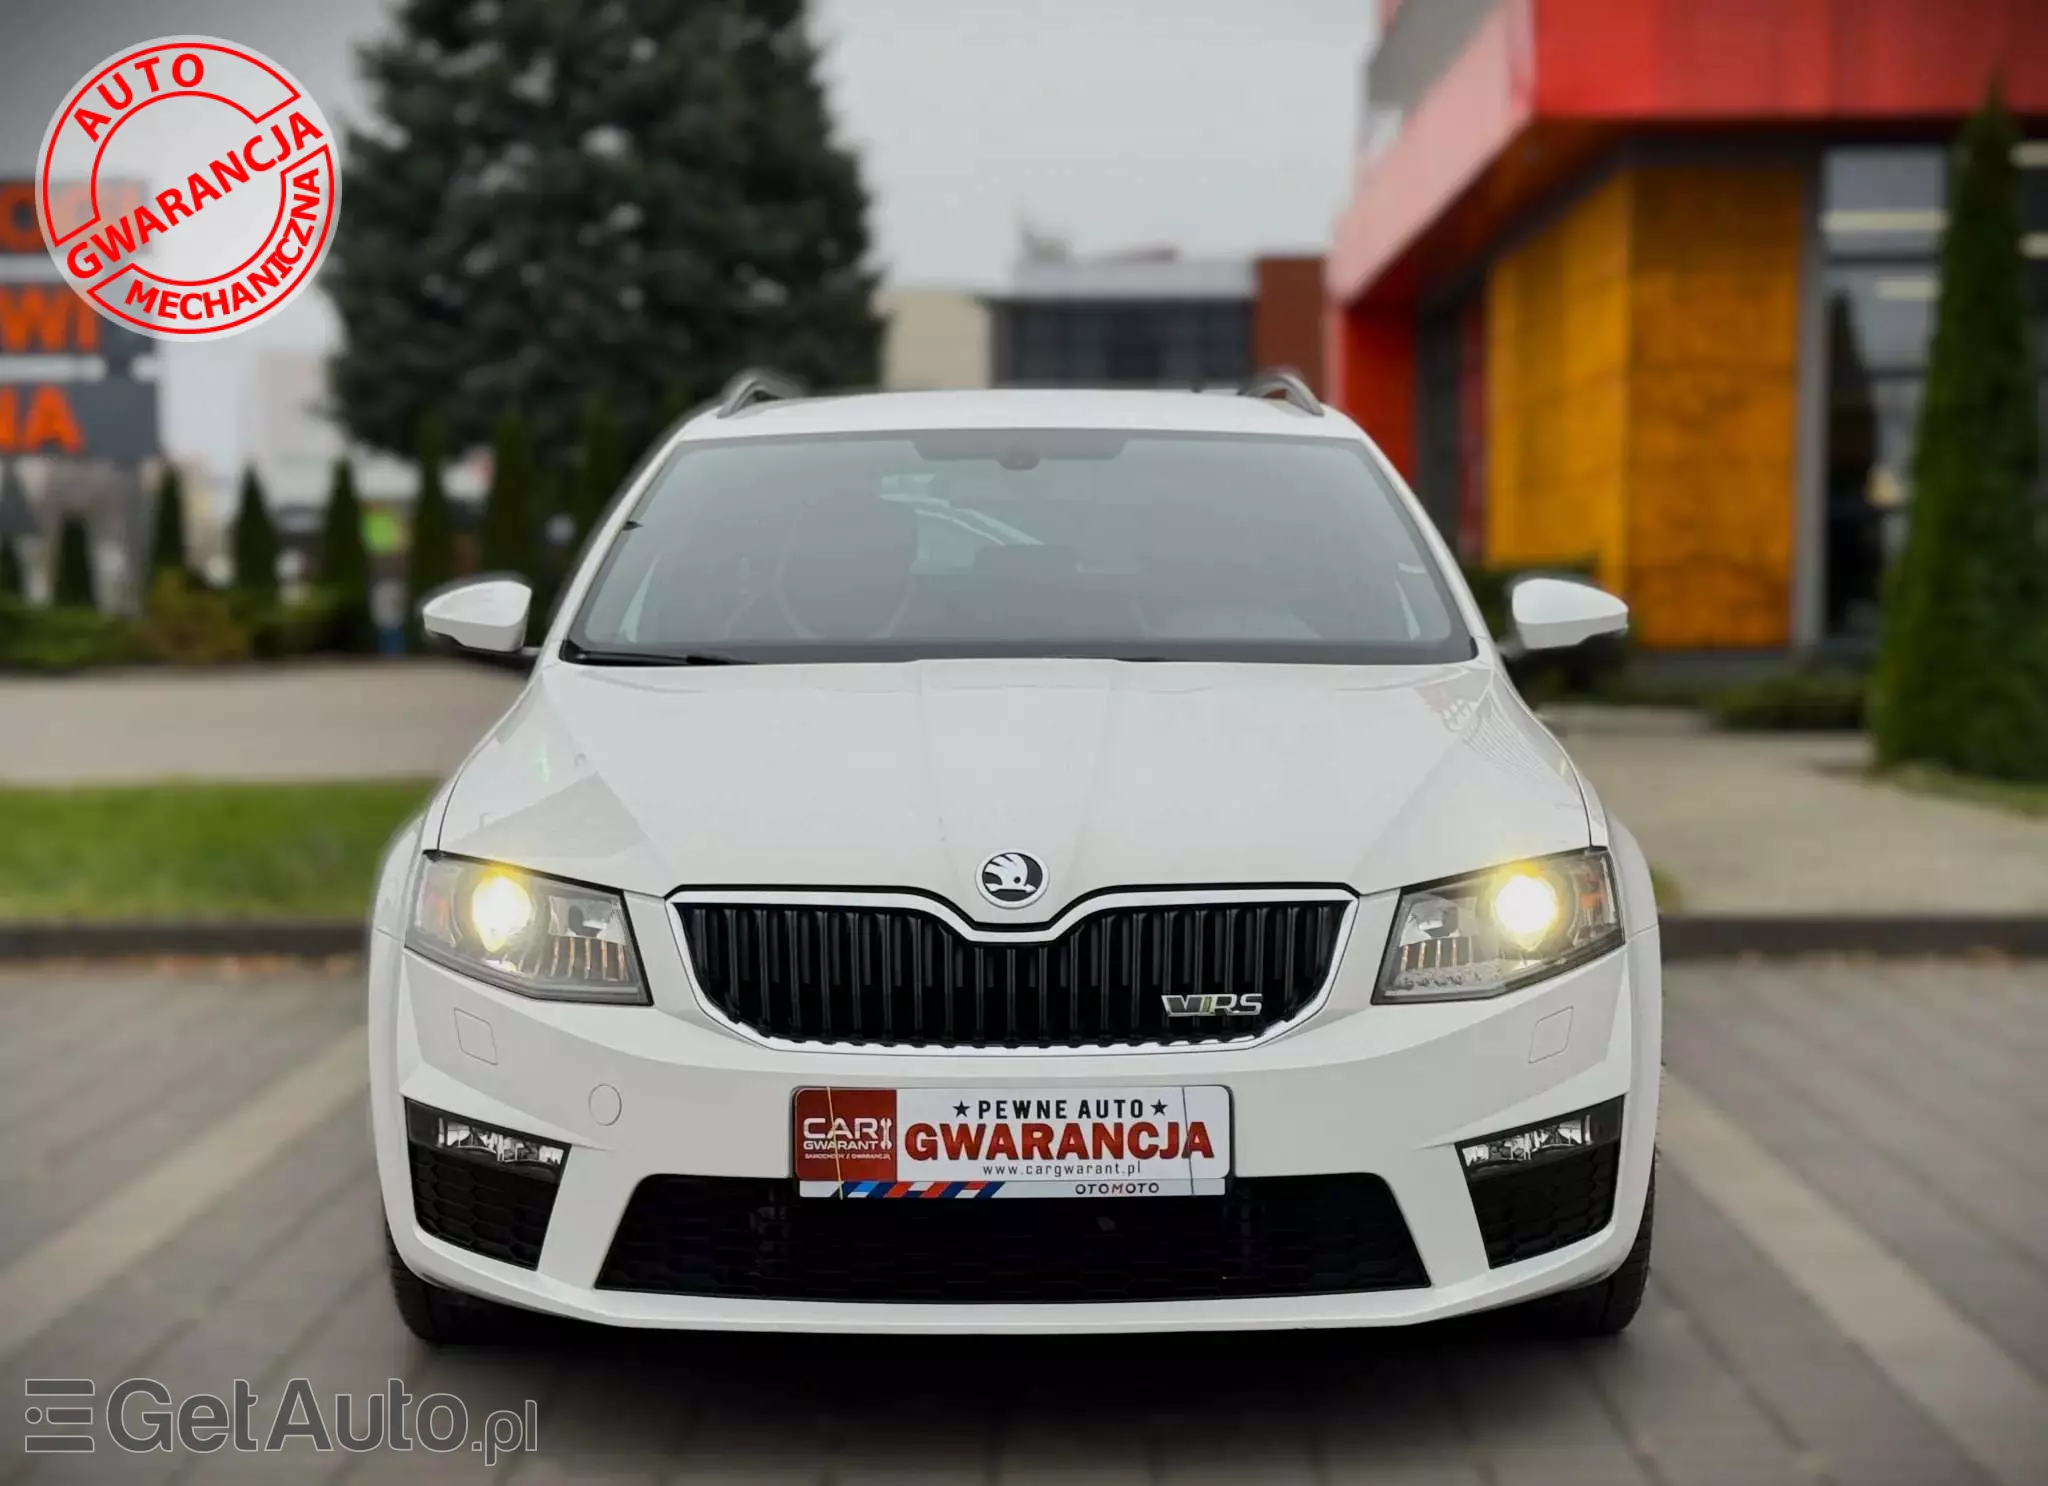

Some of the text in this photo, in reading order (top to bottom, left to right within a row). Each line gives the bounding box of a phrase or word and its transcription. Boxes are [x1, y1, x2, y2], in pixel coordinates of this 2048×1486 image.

[978, 1099, 1144, 1120] PEWNE AUTO
[803, 1117, 879, 1139] CAR
[803, 1141, 878, 1150] GWARANT
[904, 1121, 1215, 1161] GWARANCJA
[983, 1162, 1142, 1178] www.cargwarant.pl
[1075, 1182, 1160, 1196] OTOMOTO
